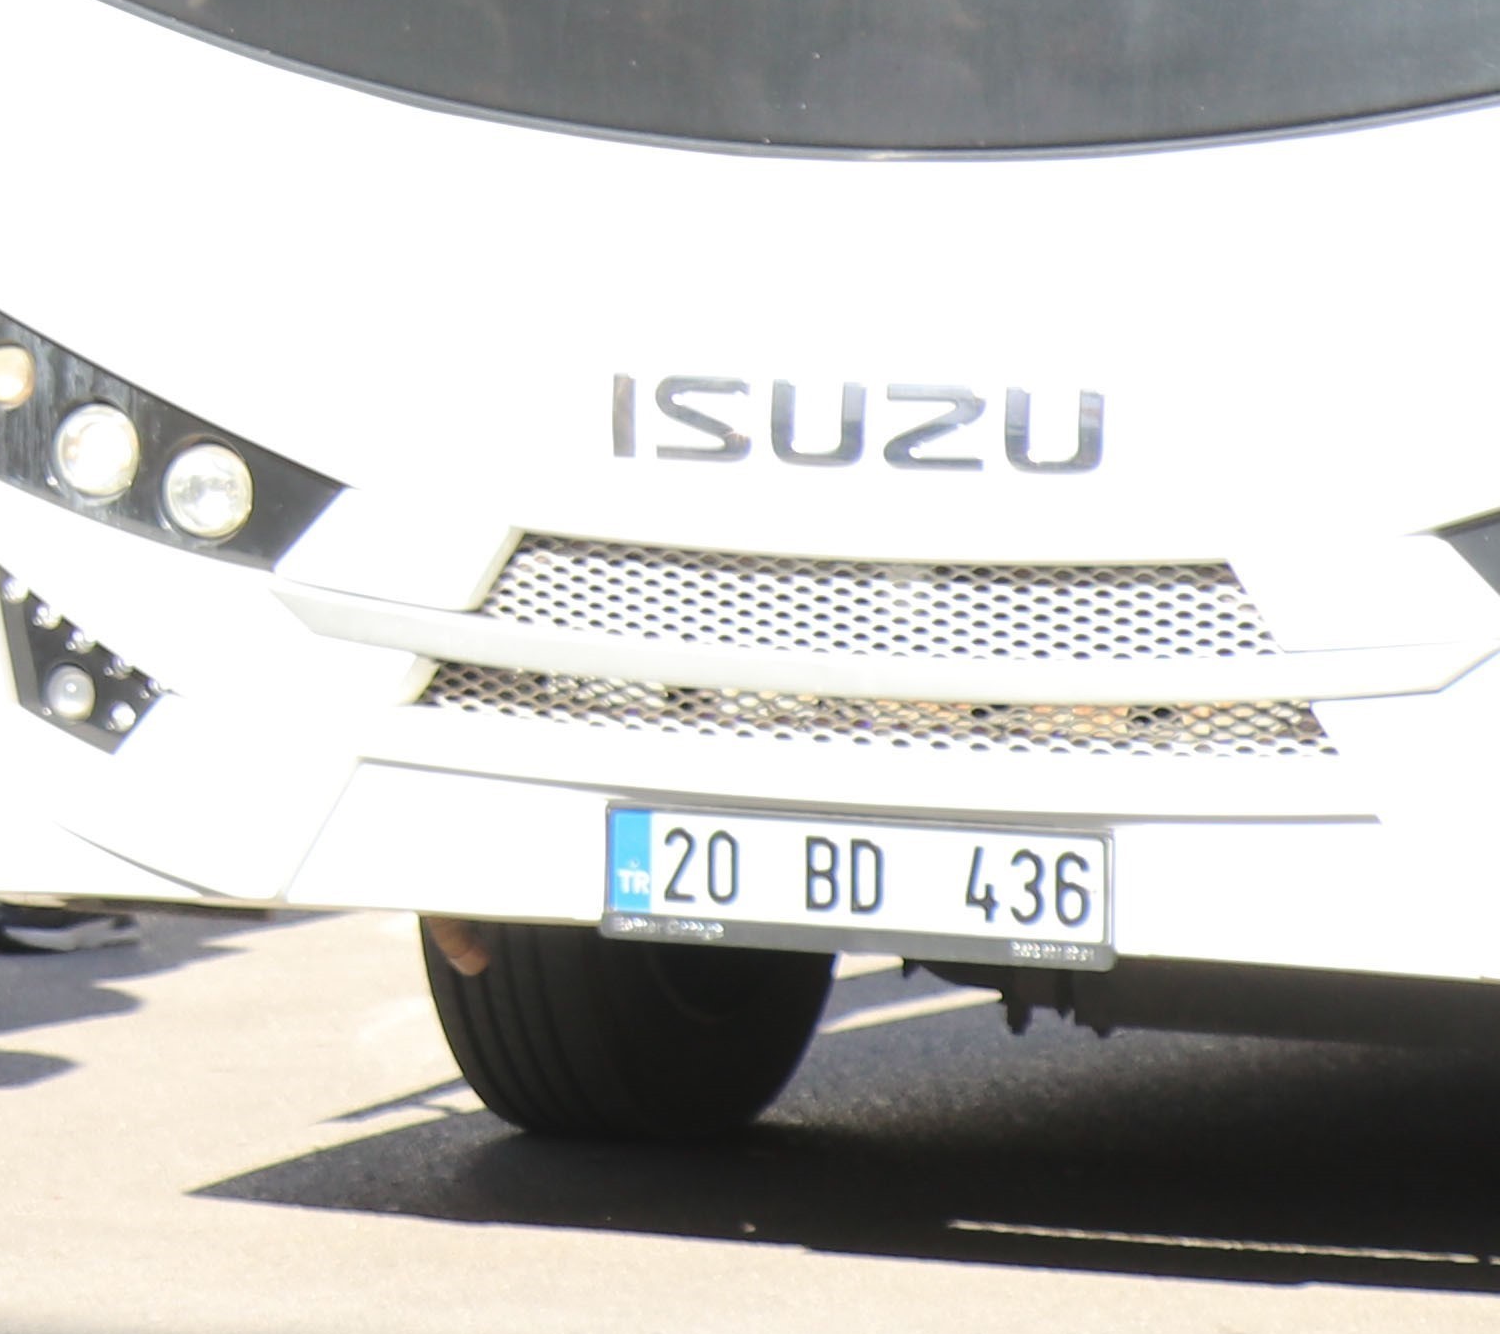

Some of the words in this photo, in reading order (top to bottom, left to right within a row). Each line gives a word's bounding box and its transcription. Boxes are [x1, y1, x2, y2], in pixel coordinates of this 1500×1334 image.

[611, 373, 1105, 475] ISUZU
[617, 868, 651, 895] TR
[663, 827, 740, 906] 20
[804, 835, 884, 915] BD
[964, 845, 1092, 928] 436
